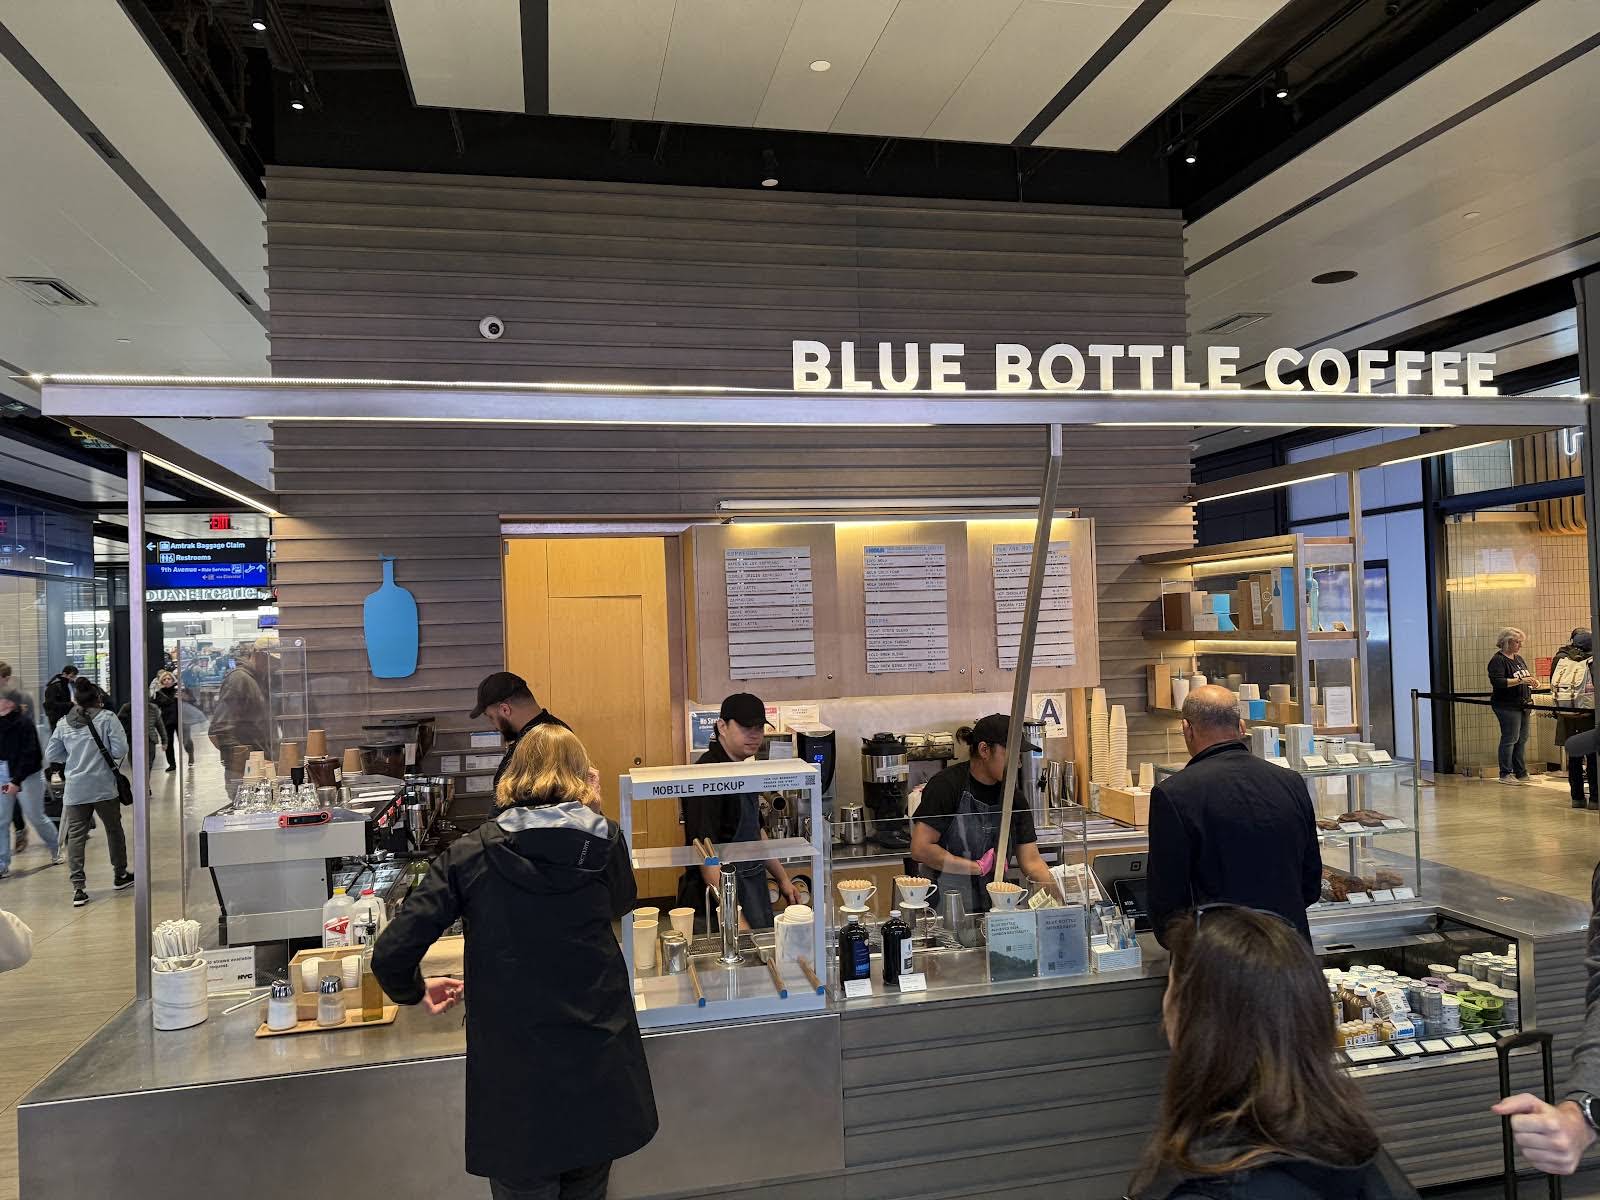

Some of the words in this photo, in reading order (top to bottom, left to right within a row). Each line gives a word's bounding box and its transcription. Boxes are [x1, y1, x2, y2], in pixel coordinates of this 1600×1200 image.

[793, 340, 966, 391] BLUE
[996, 343, 1241, 392] BOTTLE
[1264, 347, 1498, 396] COFFEE
[210, 514, 230, 529] EXIT
[197, 542, 225, 550] Baggage
[1040, 699, 1060, 724] A
[652, 784, 695, 796] MOBILE
[702, 781, 745, 793] PICKUP
